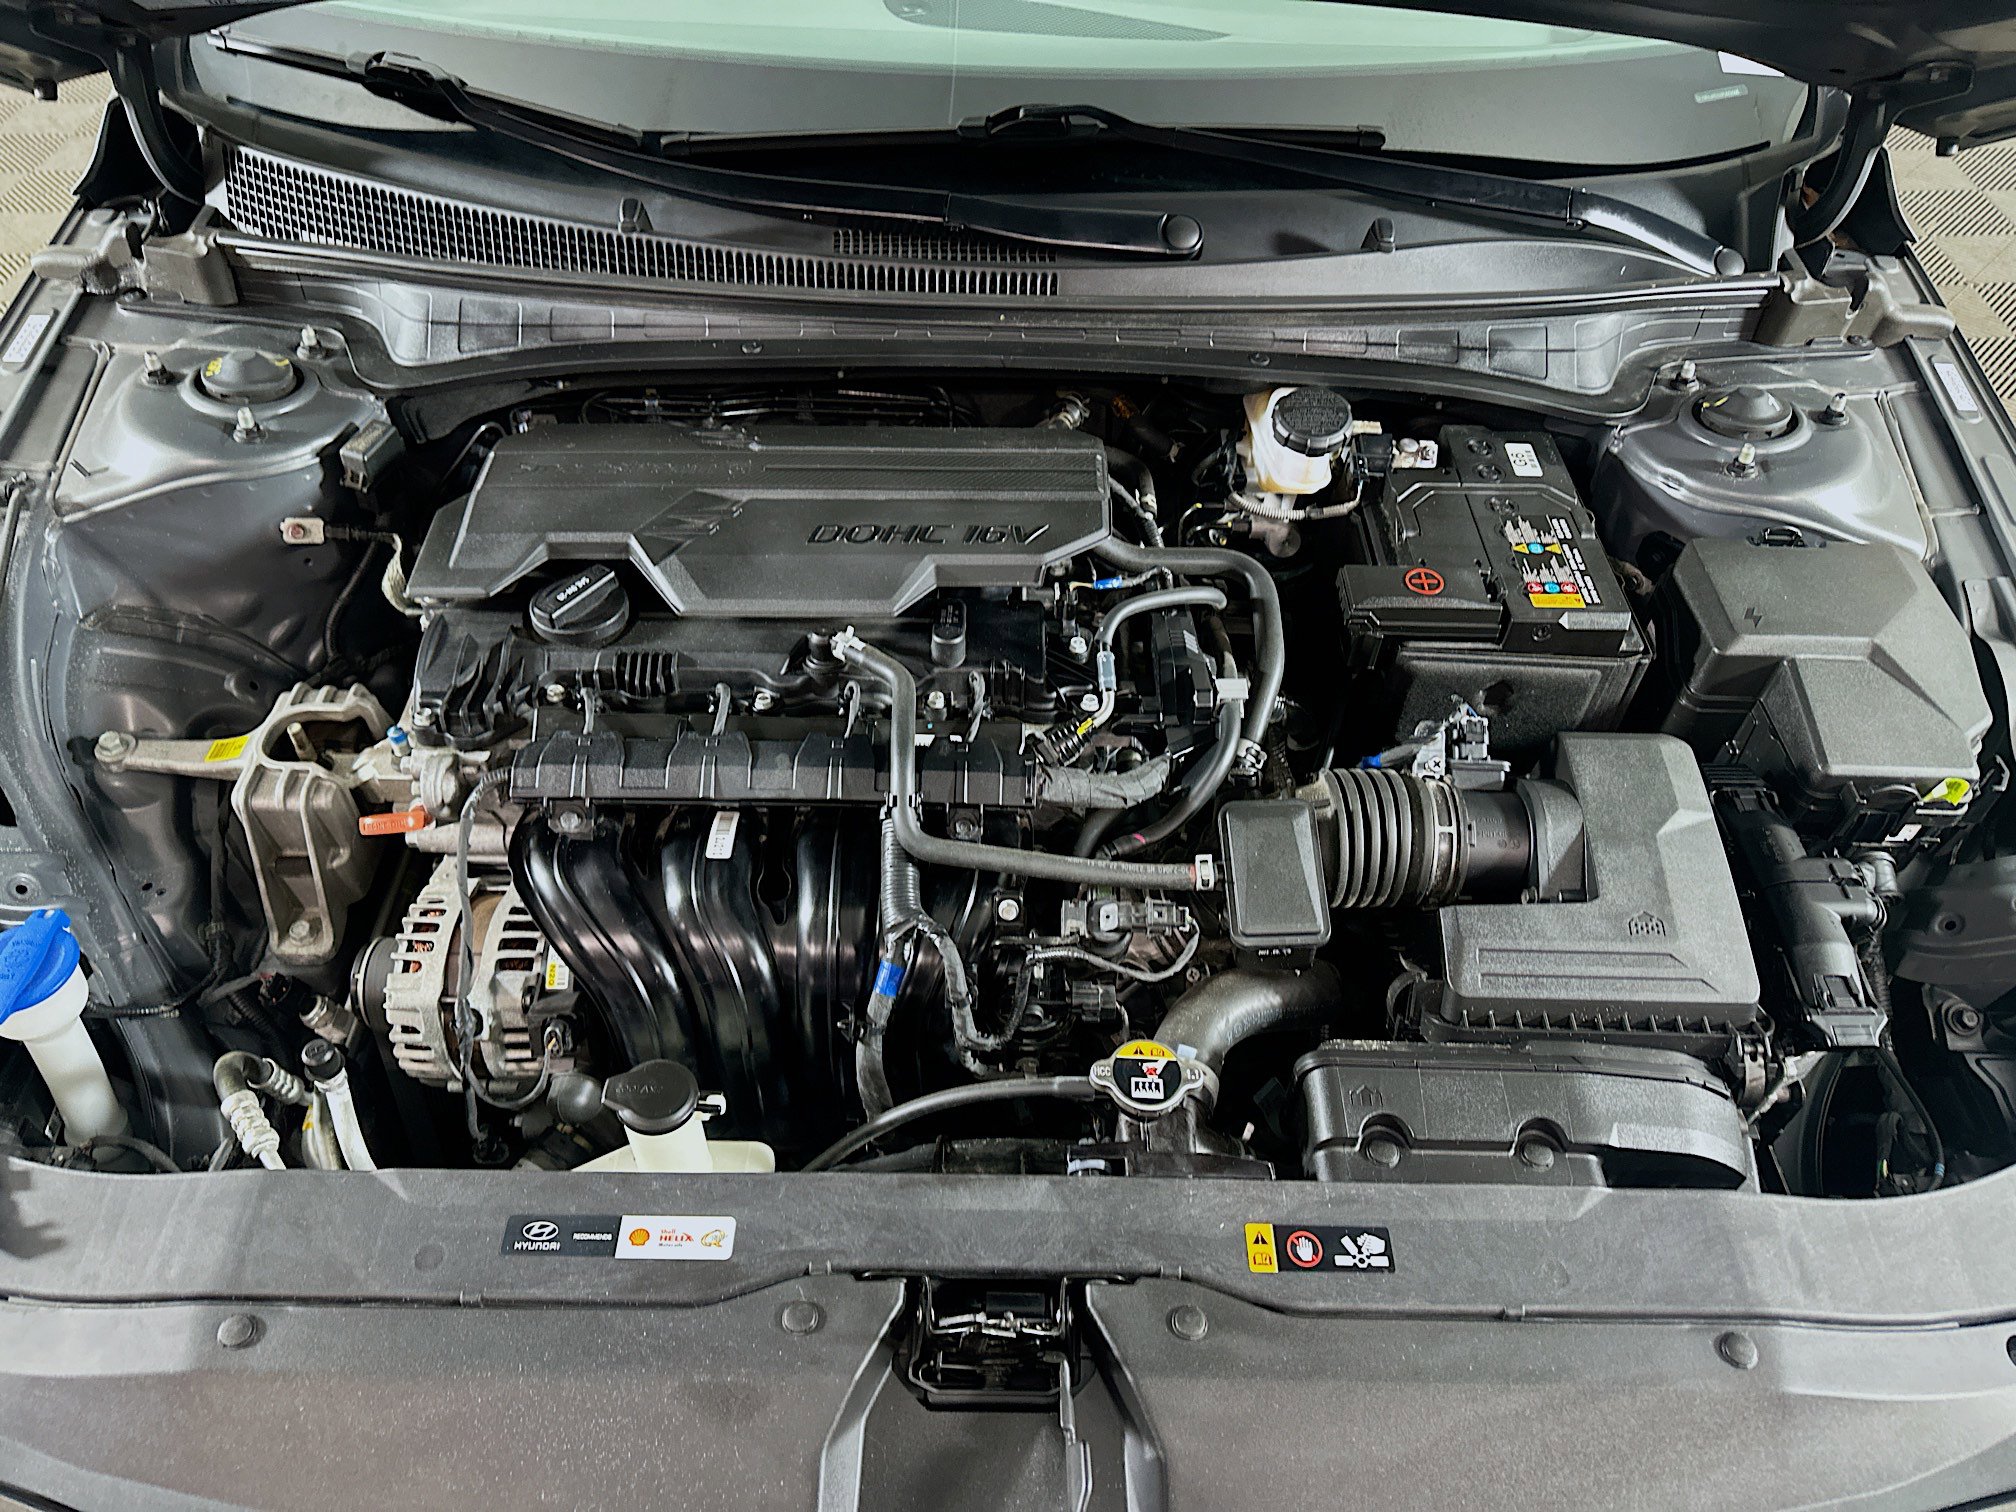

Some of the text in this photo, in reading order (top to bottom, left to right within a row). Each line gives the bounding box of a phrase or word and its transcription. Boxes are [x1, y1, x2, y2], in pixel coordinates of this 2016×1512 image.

[806, 523, 1050, 545] DOHC 16V
[660, 1232, 695, 1242] HELIX
[513, 1241, 561, 1251] HYUNDAI
